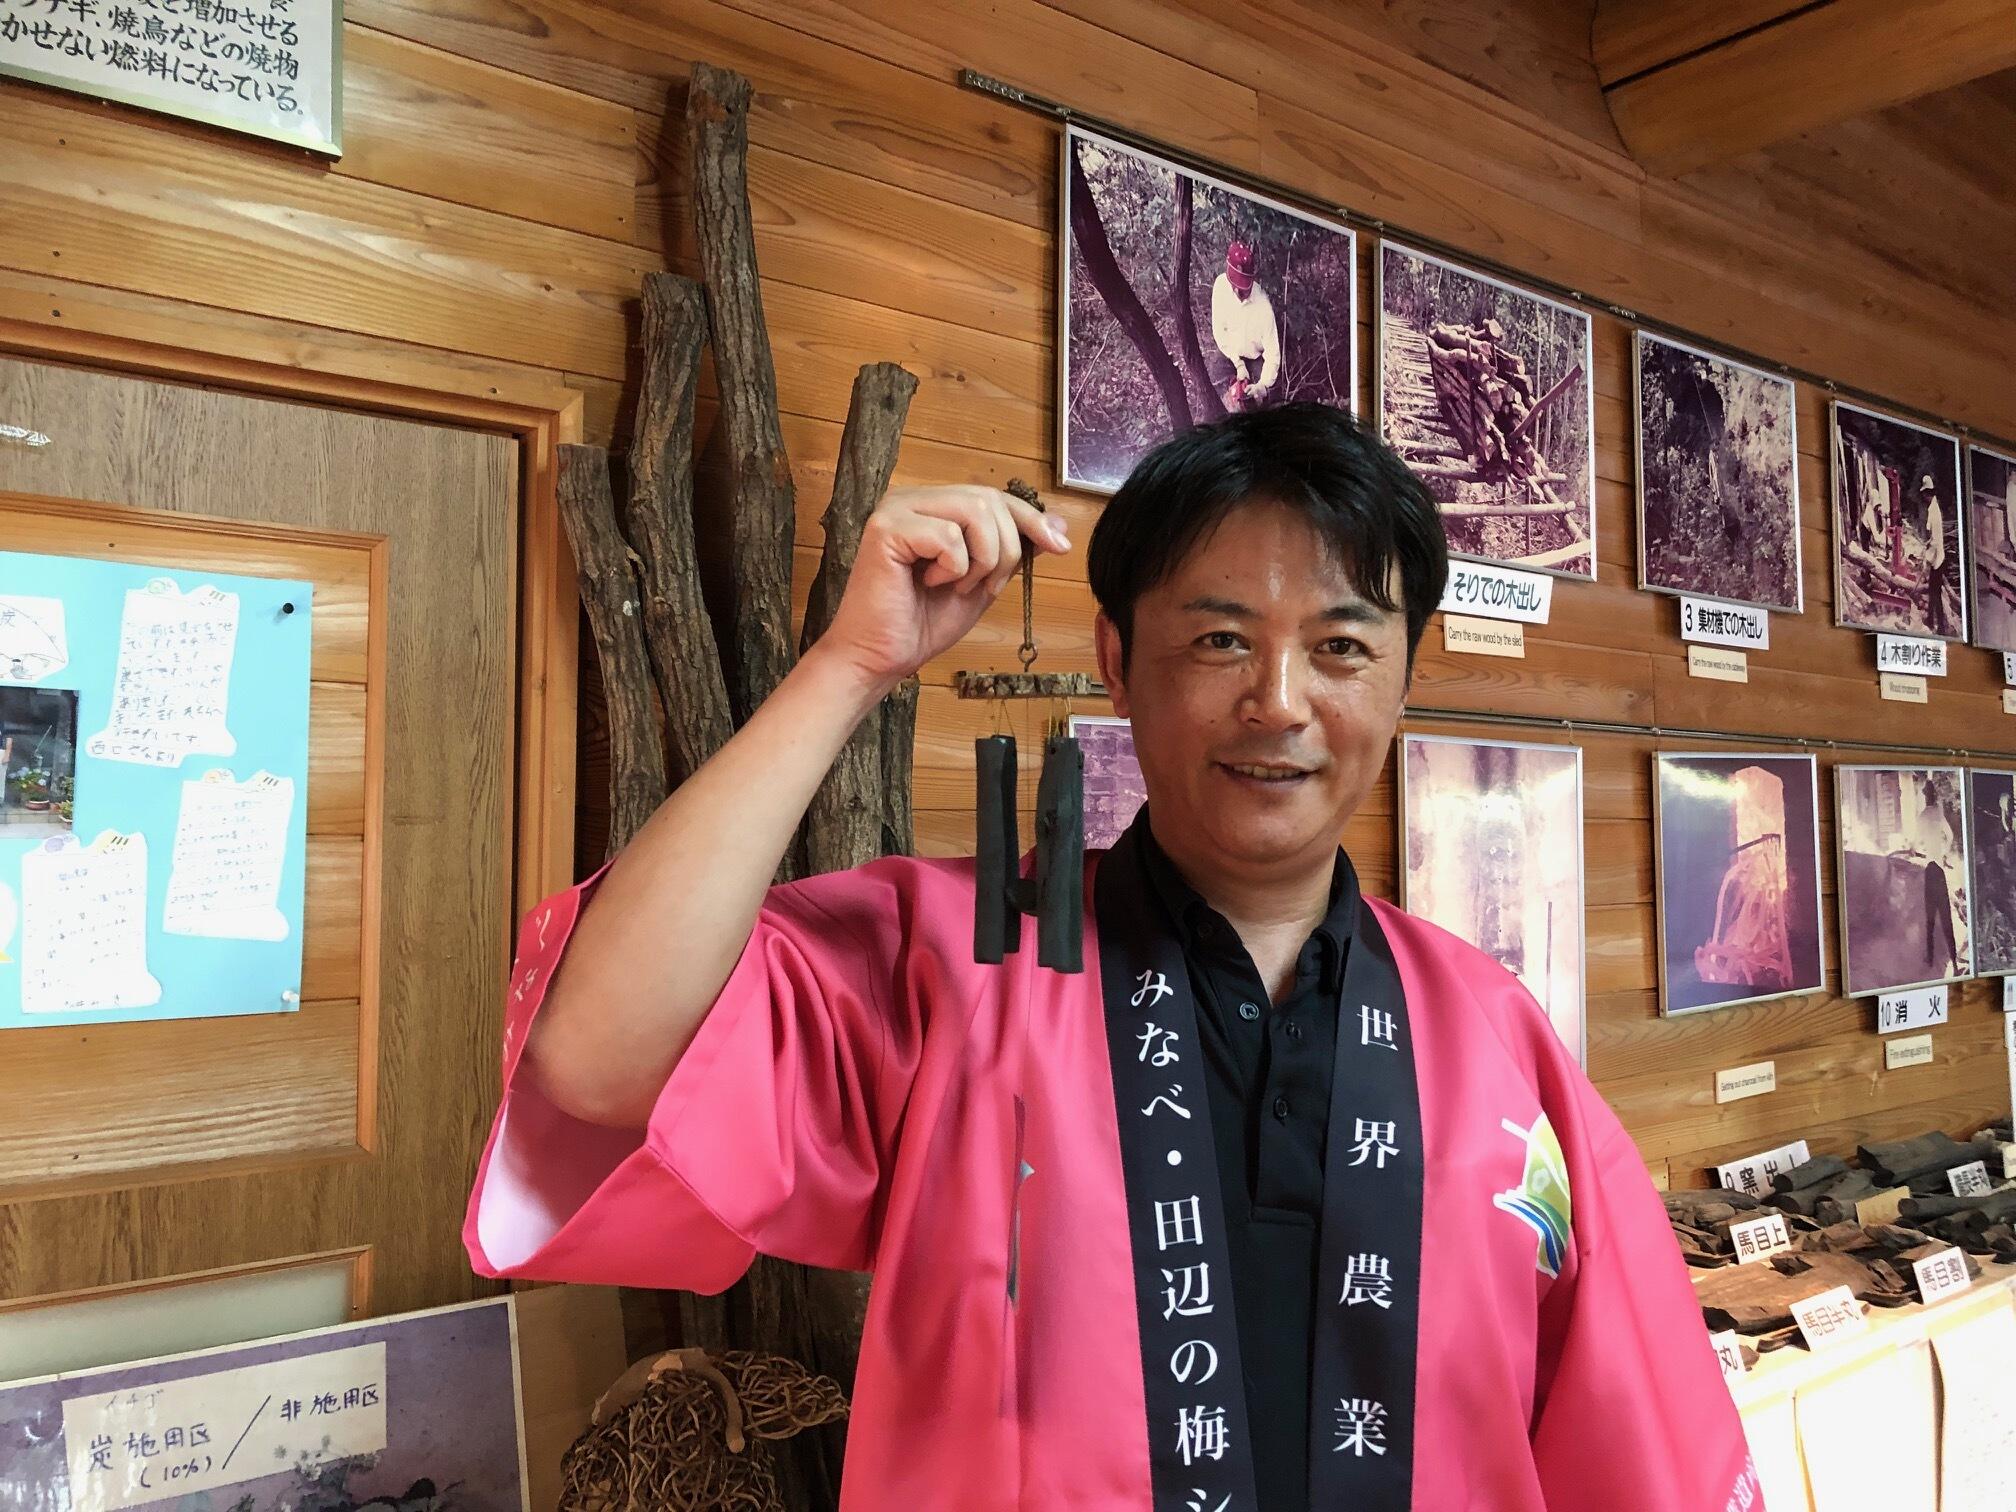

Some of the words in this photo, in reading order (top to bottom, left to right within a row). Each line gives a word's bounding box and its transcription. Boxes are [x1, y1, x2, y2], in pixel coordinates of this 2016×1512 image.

[1453, 572, 1542, 612] そりでの木出し
[1685, 603, 1693, 632] 3
[1332, 1004, 1400, 1458] 世界農業
[1737, 1223, 1786, 1257] 馬目上
